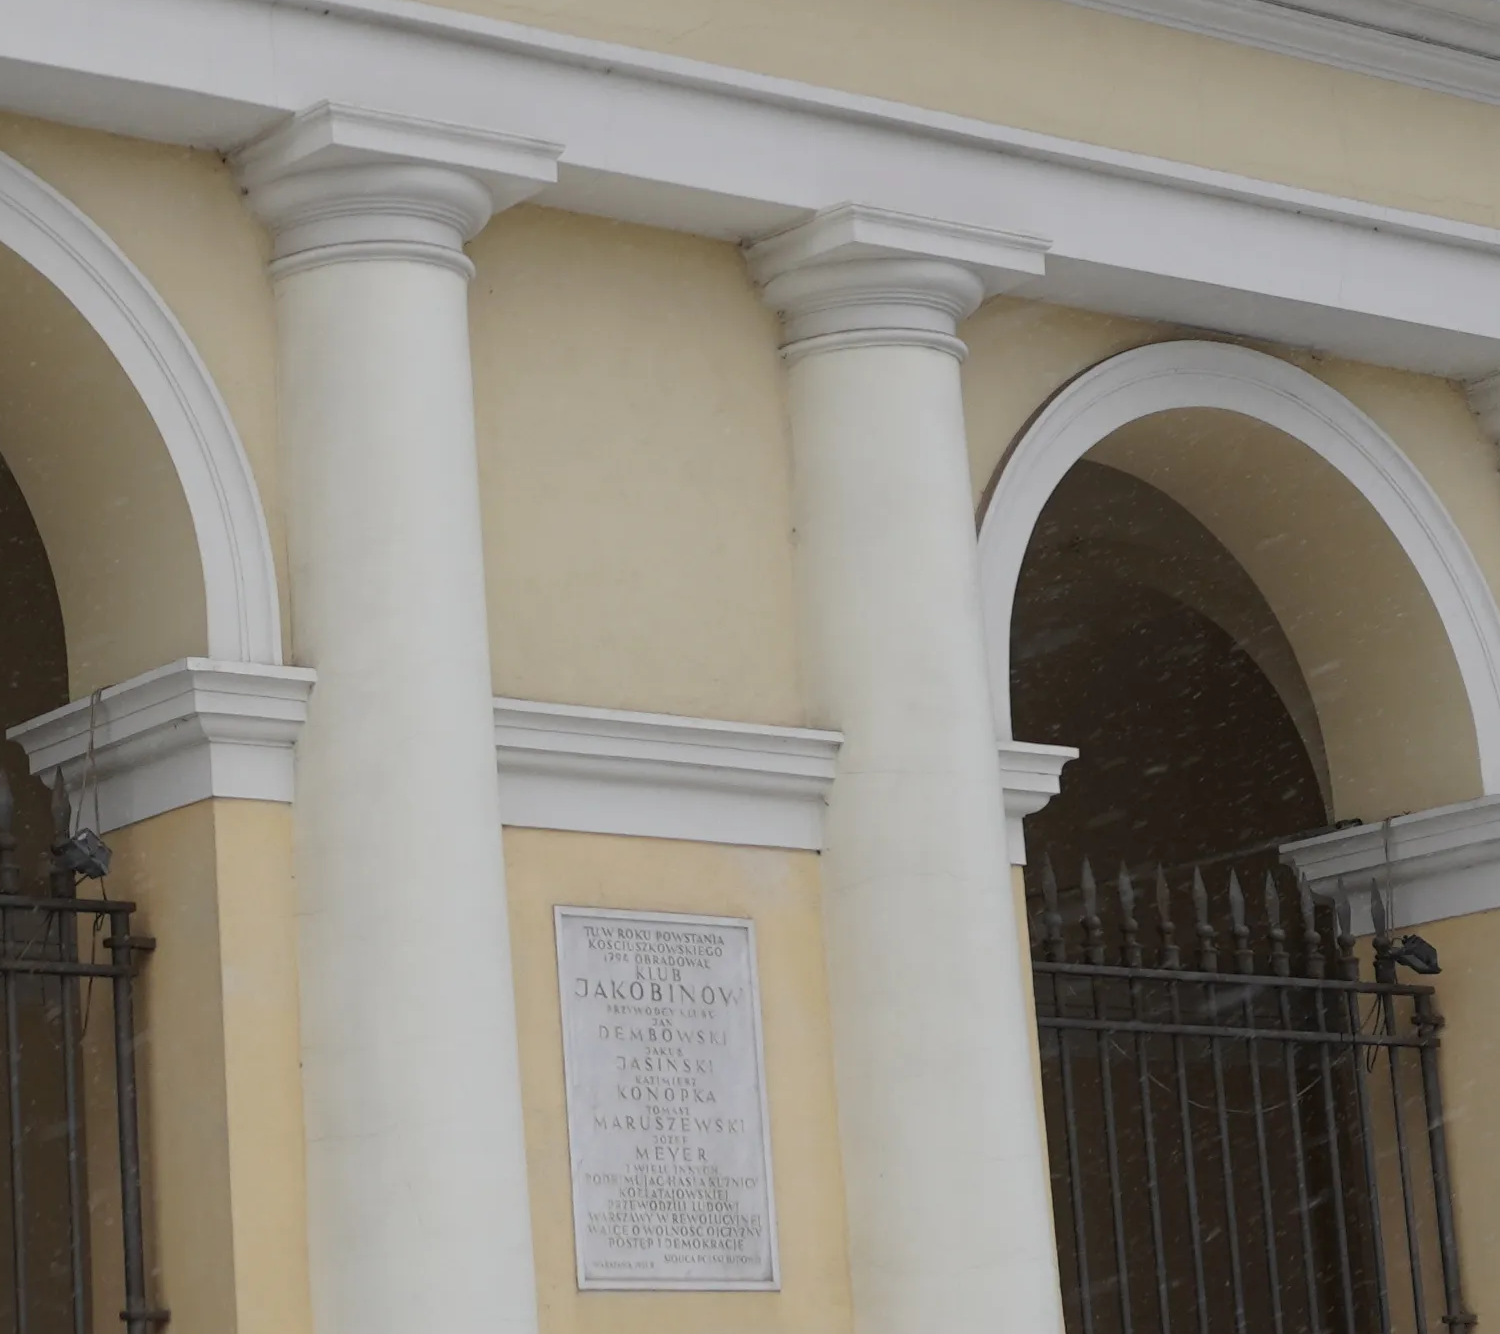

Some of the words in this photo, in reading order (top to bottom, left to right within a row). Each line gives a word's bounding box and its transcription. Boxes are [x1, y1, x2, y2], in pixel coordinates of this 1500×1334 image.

[601, 927, 613, 938] W
[617, 928, 651, 941] ROKU
[655, 931, 725, 946] POWSTANIA
[636, 966, 682, 982] KLUB
[598, 1024, 727, 1046] DEMBOWSKI
[616, 1083, 717, 1104] KONOPKA
[594, 1114, 746, 1134] MARUSZEWSKI
[635, 1146, 709, 1162] MEYER
